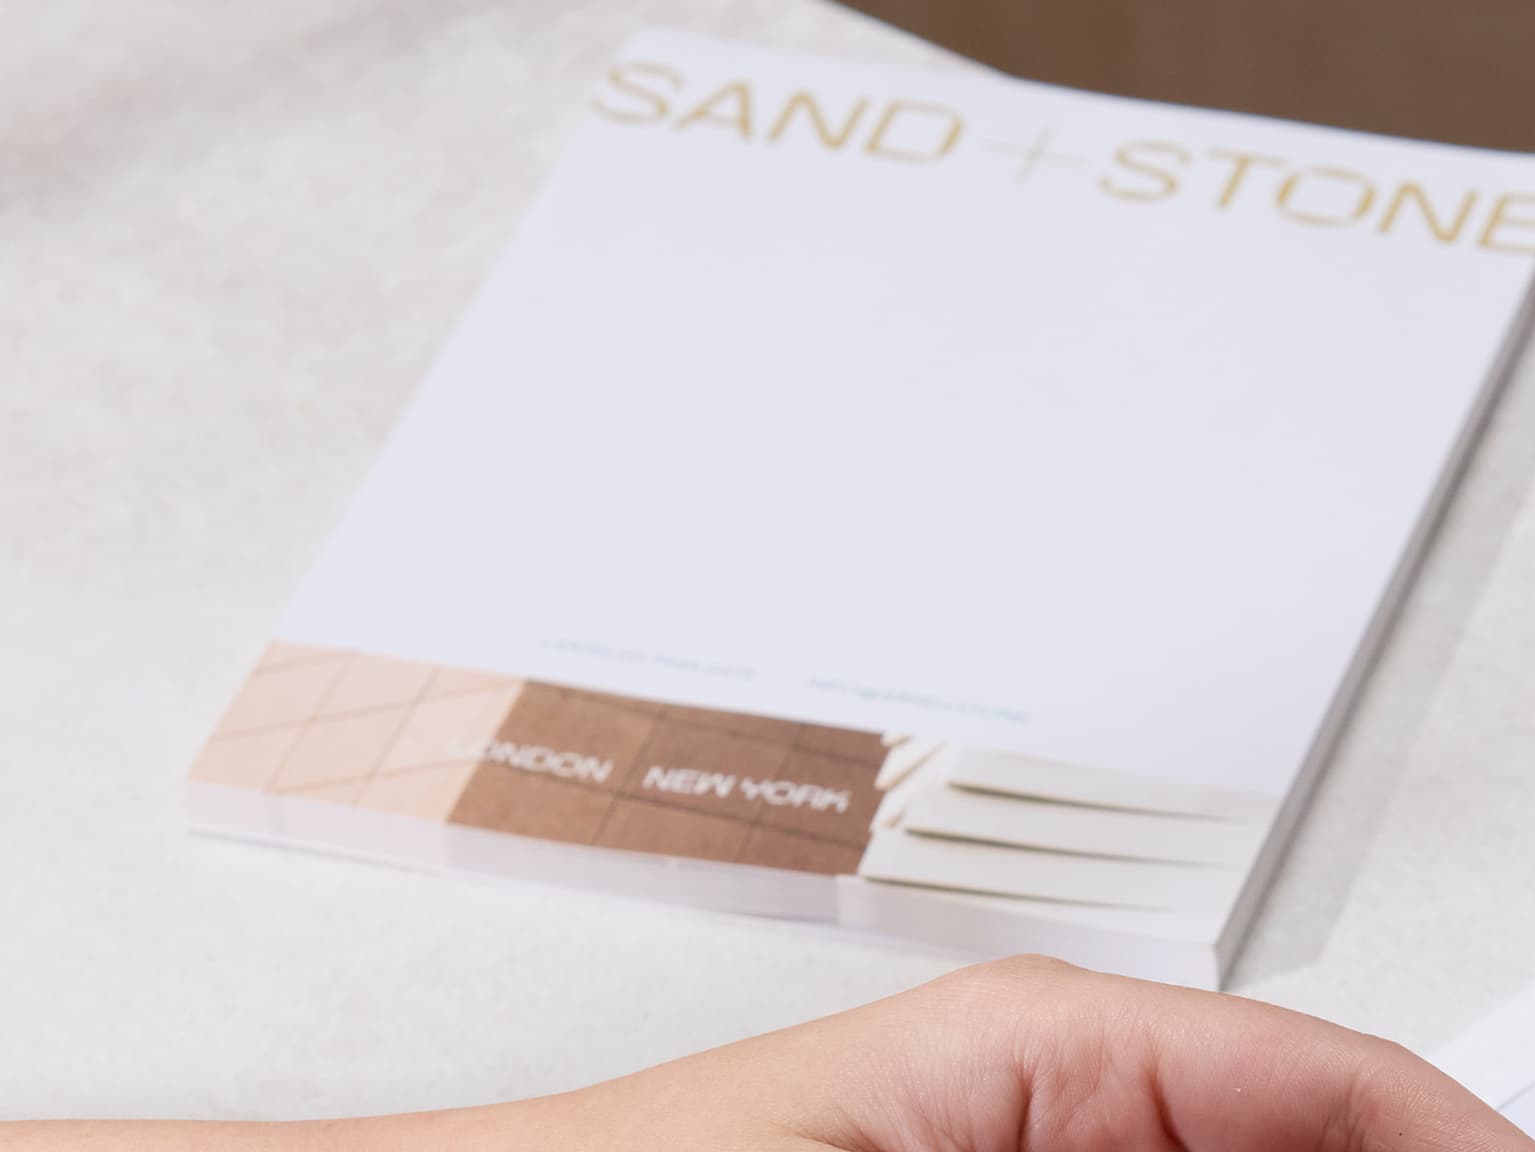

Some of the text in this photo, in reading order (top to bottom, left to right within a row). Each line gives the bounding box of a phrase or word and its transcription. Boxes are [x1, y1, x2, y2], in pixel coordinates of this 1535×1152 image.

[591, 60, 966, 165] SAND
[642, 765, 737, 799] NEW
[740, 777, 850, 814] YORK
